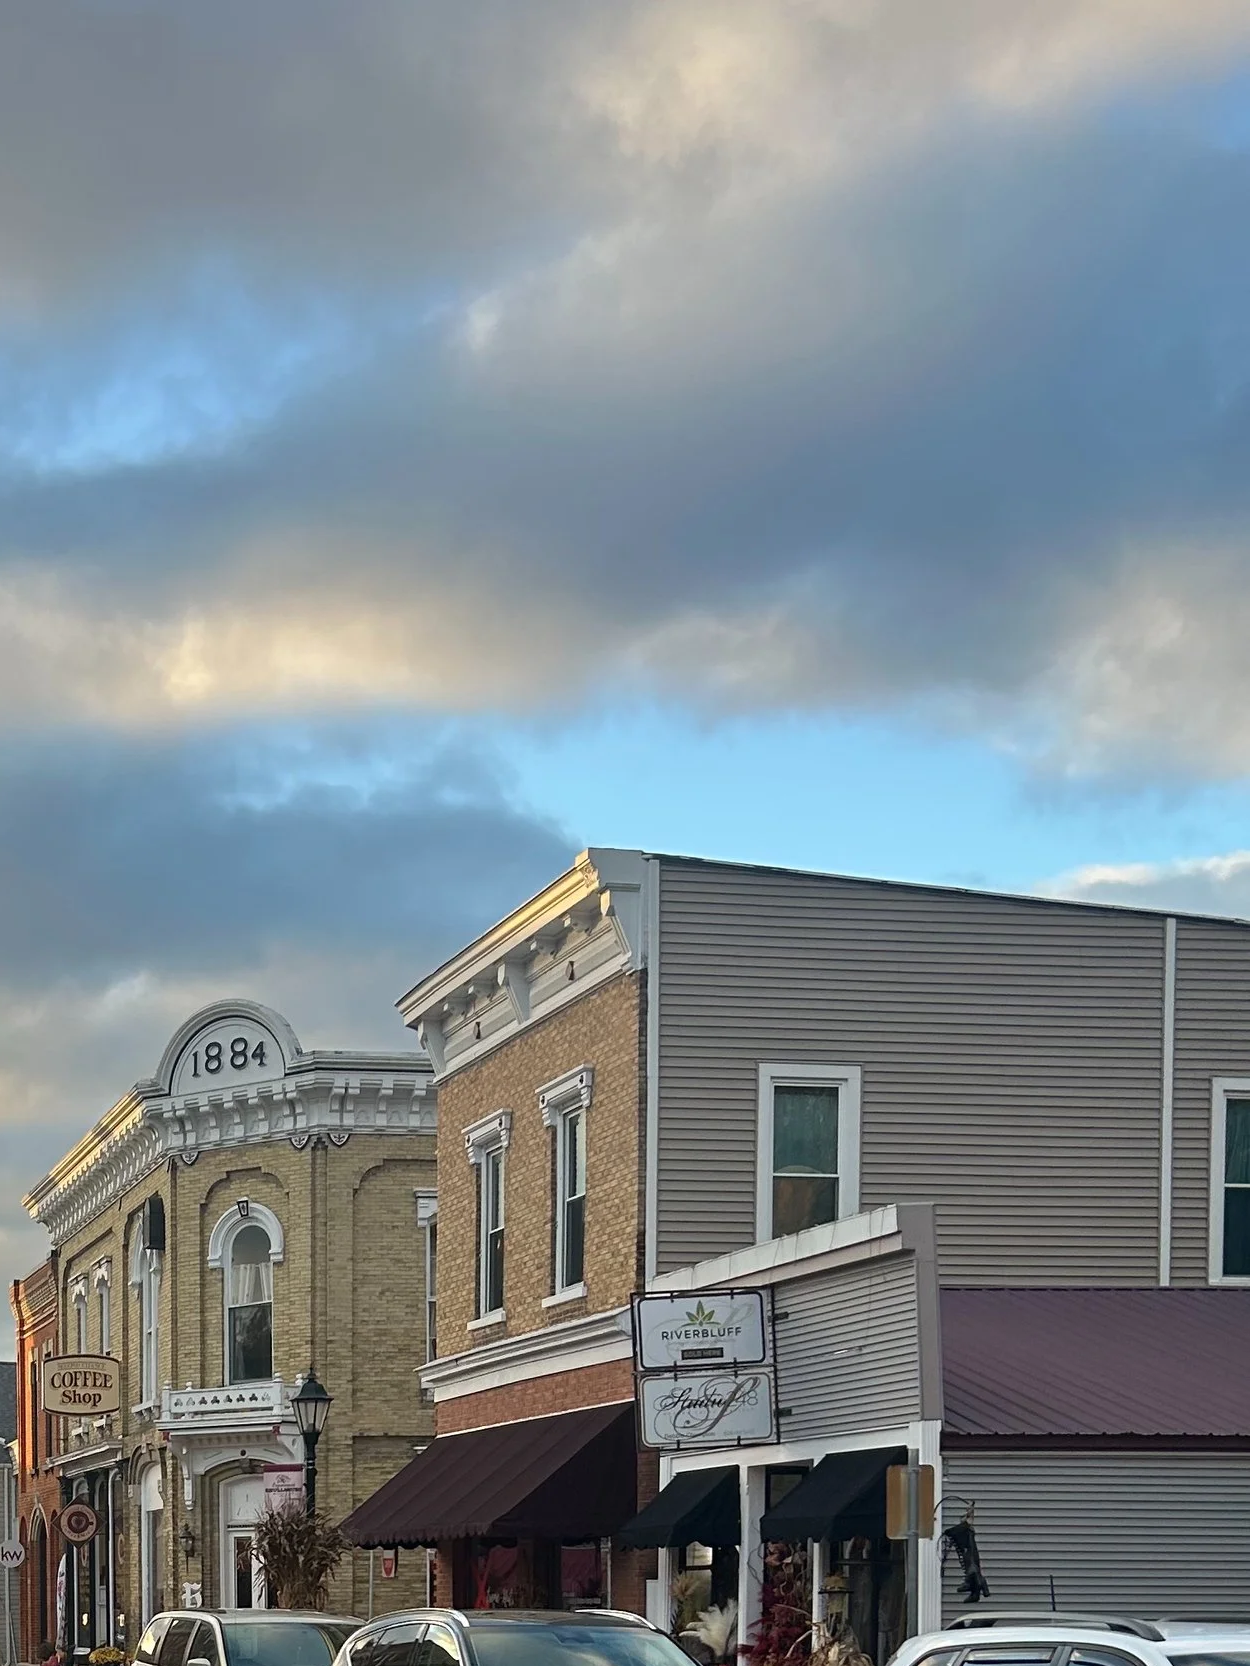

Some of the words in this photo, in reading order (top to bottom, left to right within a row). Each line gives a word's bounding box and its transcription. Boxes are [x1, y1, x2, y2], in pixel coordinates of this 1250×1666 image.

[192, 1037, 267, 1077] 1884
[661, 1327, 742, 1341] RIVERBLUFF
[51, 1371, 113, 1389] COFFEE
[61, 1390, 102, 1407] Shop
